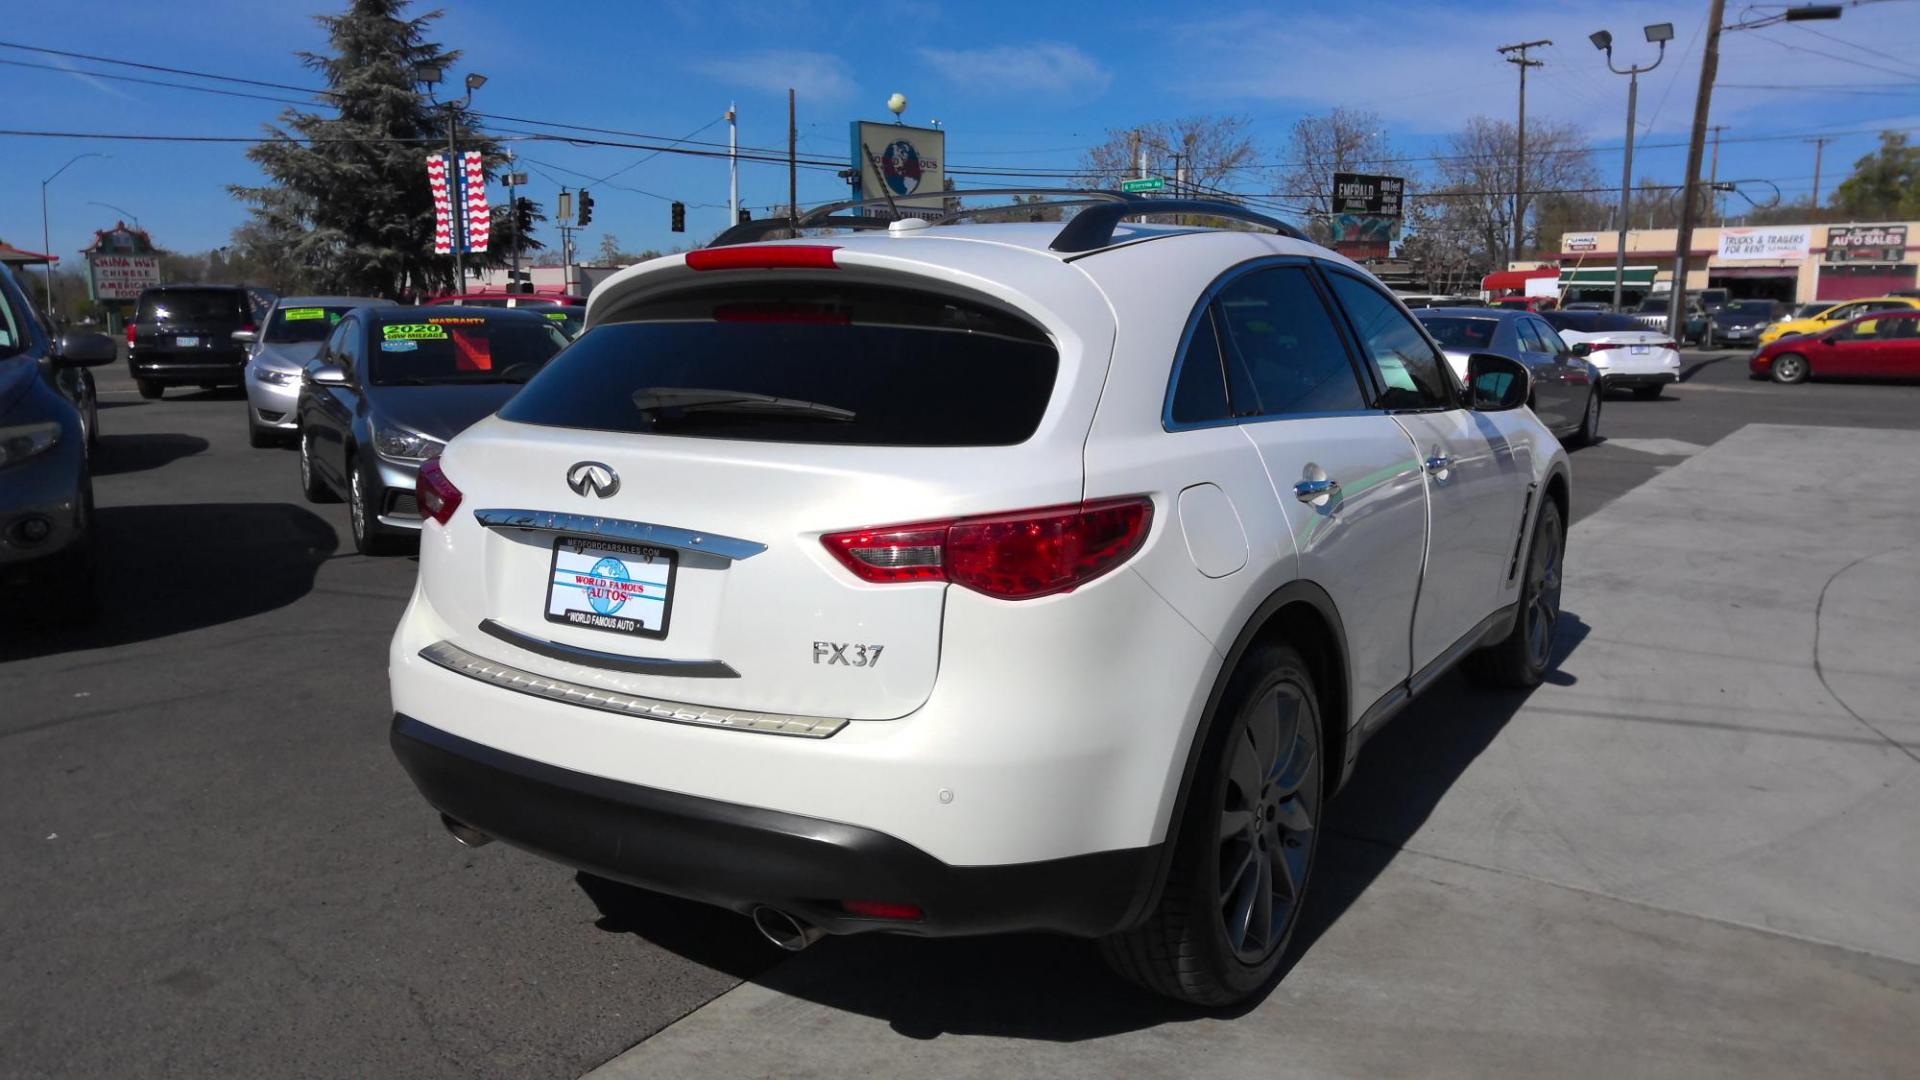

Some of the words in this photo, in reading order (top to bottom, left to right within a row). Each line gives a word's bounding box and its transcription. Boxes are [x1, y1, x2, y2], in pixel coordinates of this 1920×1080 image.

[1339, 183, 1374, 199] EMERALD
[1725, 236, 1754, 244] TRUCKS
[1757, 235, 1763, 244] &
[1768, 235, 1804, 244] TRAILERS
[1864, 234, 1901, 246] SALES
[1725, 246, 1741, 254] FOR
[1744, 245, 1764, 254] RENT
[95, 256, 129, 267] CHINA
[135, 257, 156, 268] HUT
[386, 325, 439, 333] 2020
[575, 575, 607, 586] WORLD
[609, 581, 645, 593] FAMOUS
[590, 588, 628, 601] AUTOS
[569, 612, 591, 624] WORLD
[592, 615, 616, 629] FAMOUS
[616, 620, 634, 631] AUTO
[813, 641, 884, 668] FX37
